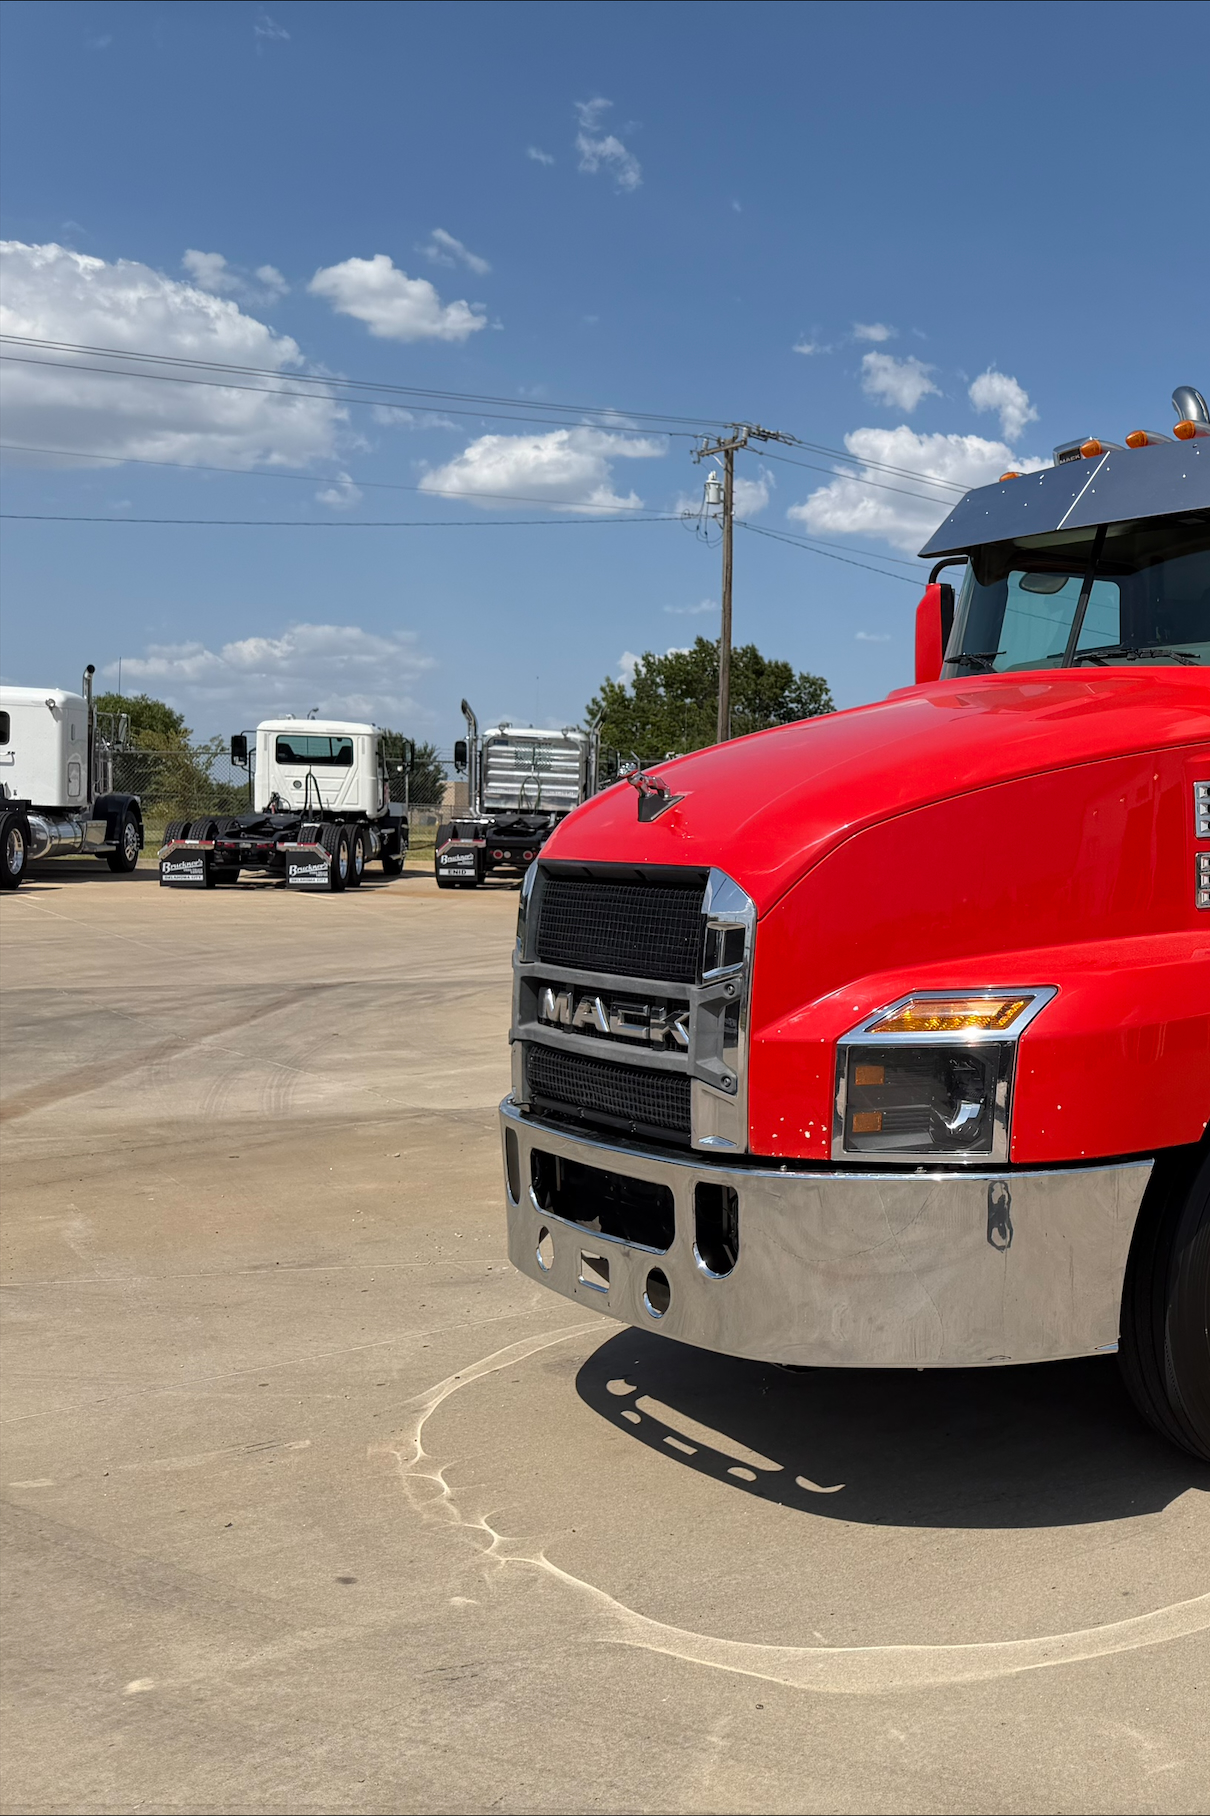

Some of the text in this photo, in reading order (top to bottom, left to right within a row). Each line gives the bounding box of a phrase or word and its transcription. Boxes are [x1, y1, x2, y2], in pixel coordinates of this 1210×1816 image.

[1060, 454, 1081, 464] MACK
[162, 859, 203, 874] Bruckner's
[289, 862, 328, 876] Bruckner's
[538, 987, 690, 1046] MACK
